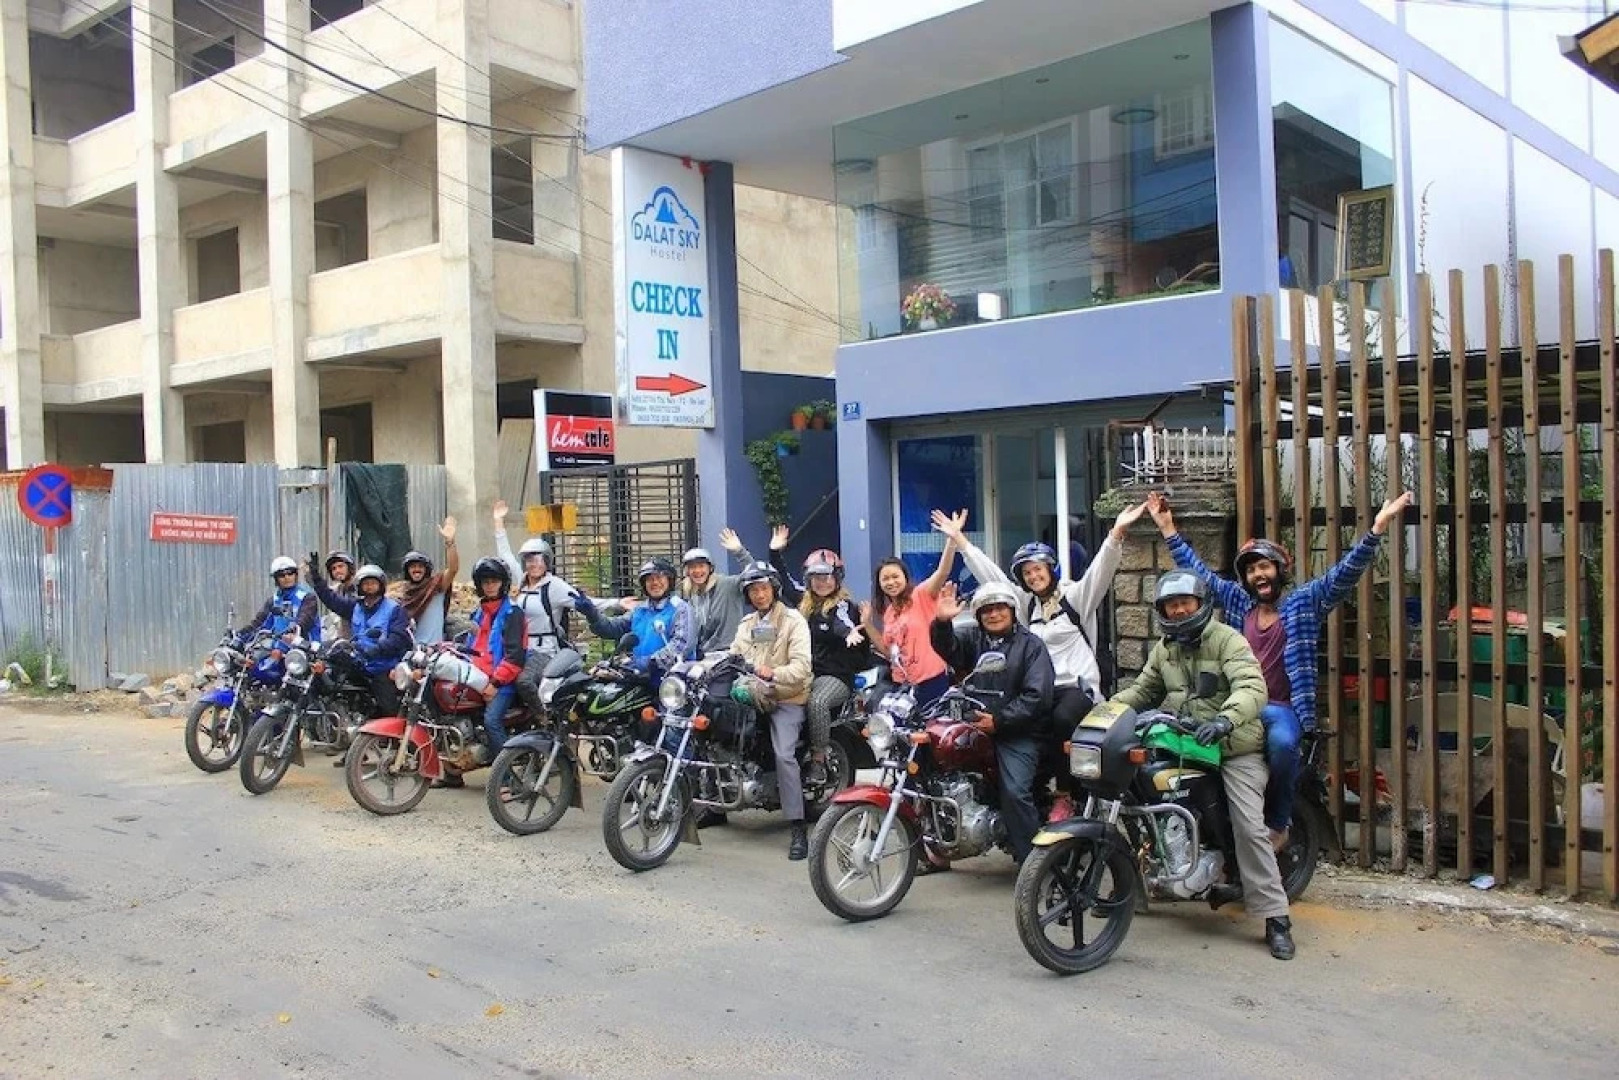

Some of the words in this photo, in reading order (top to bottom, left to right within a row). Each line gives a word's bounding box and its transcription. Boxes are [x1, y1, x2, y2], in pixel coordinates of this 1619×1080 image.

[634, 222, 676, 246] DALAT
[678, 229, 700, 249] SKY
[650, 246, 687, 261] Hostel
[631, 281, 703, 318] CHECK
[657, 328, 679, 360] IN
